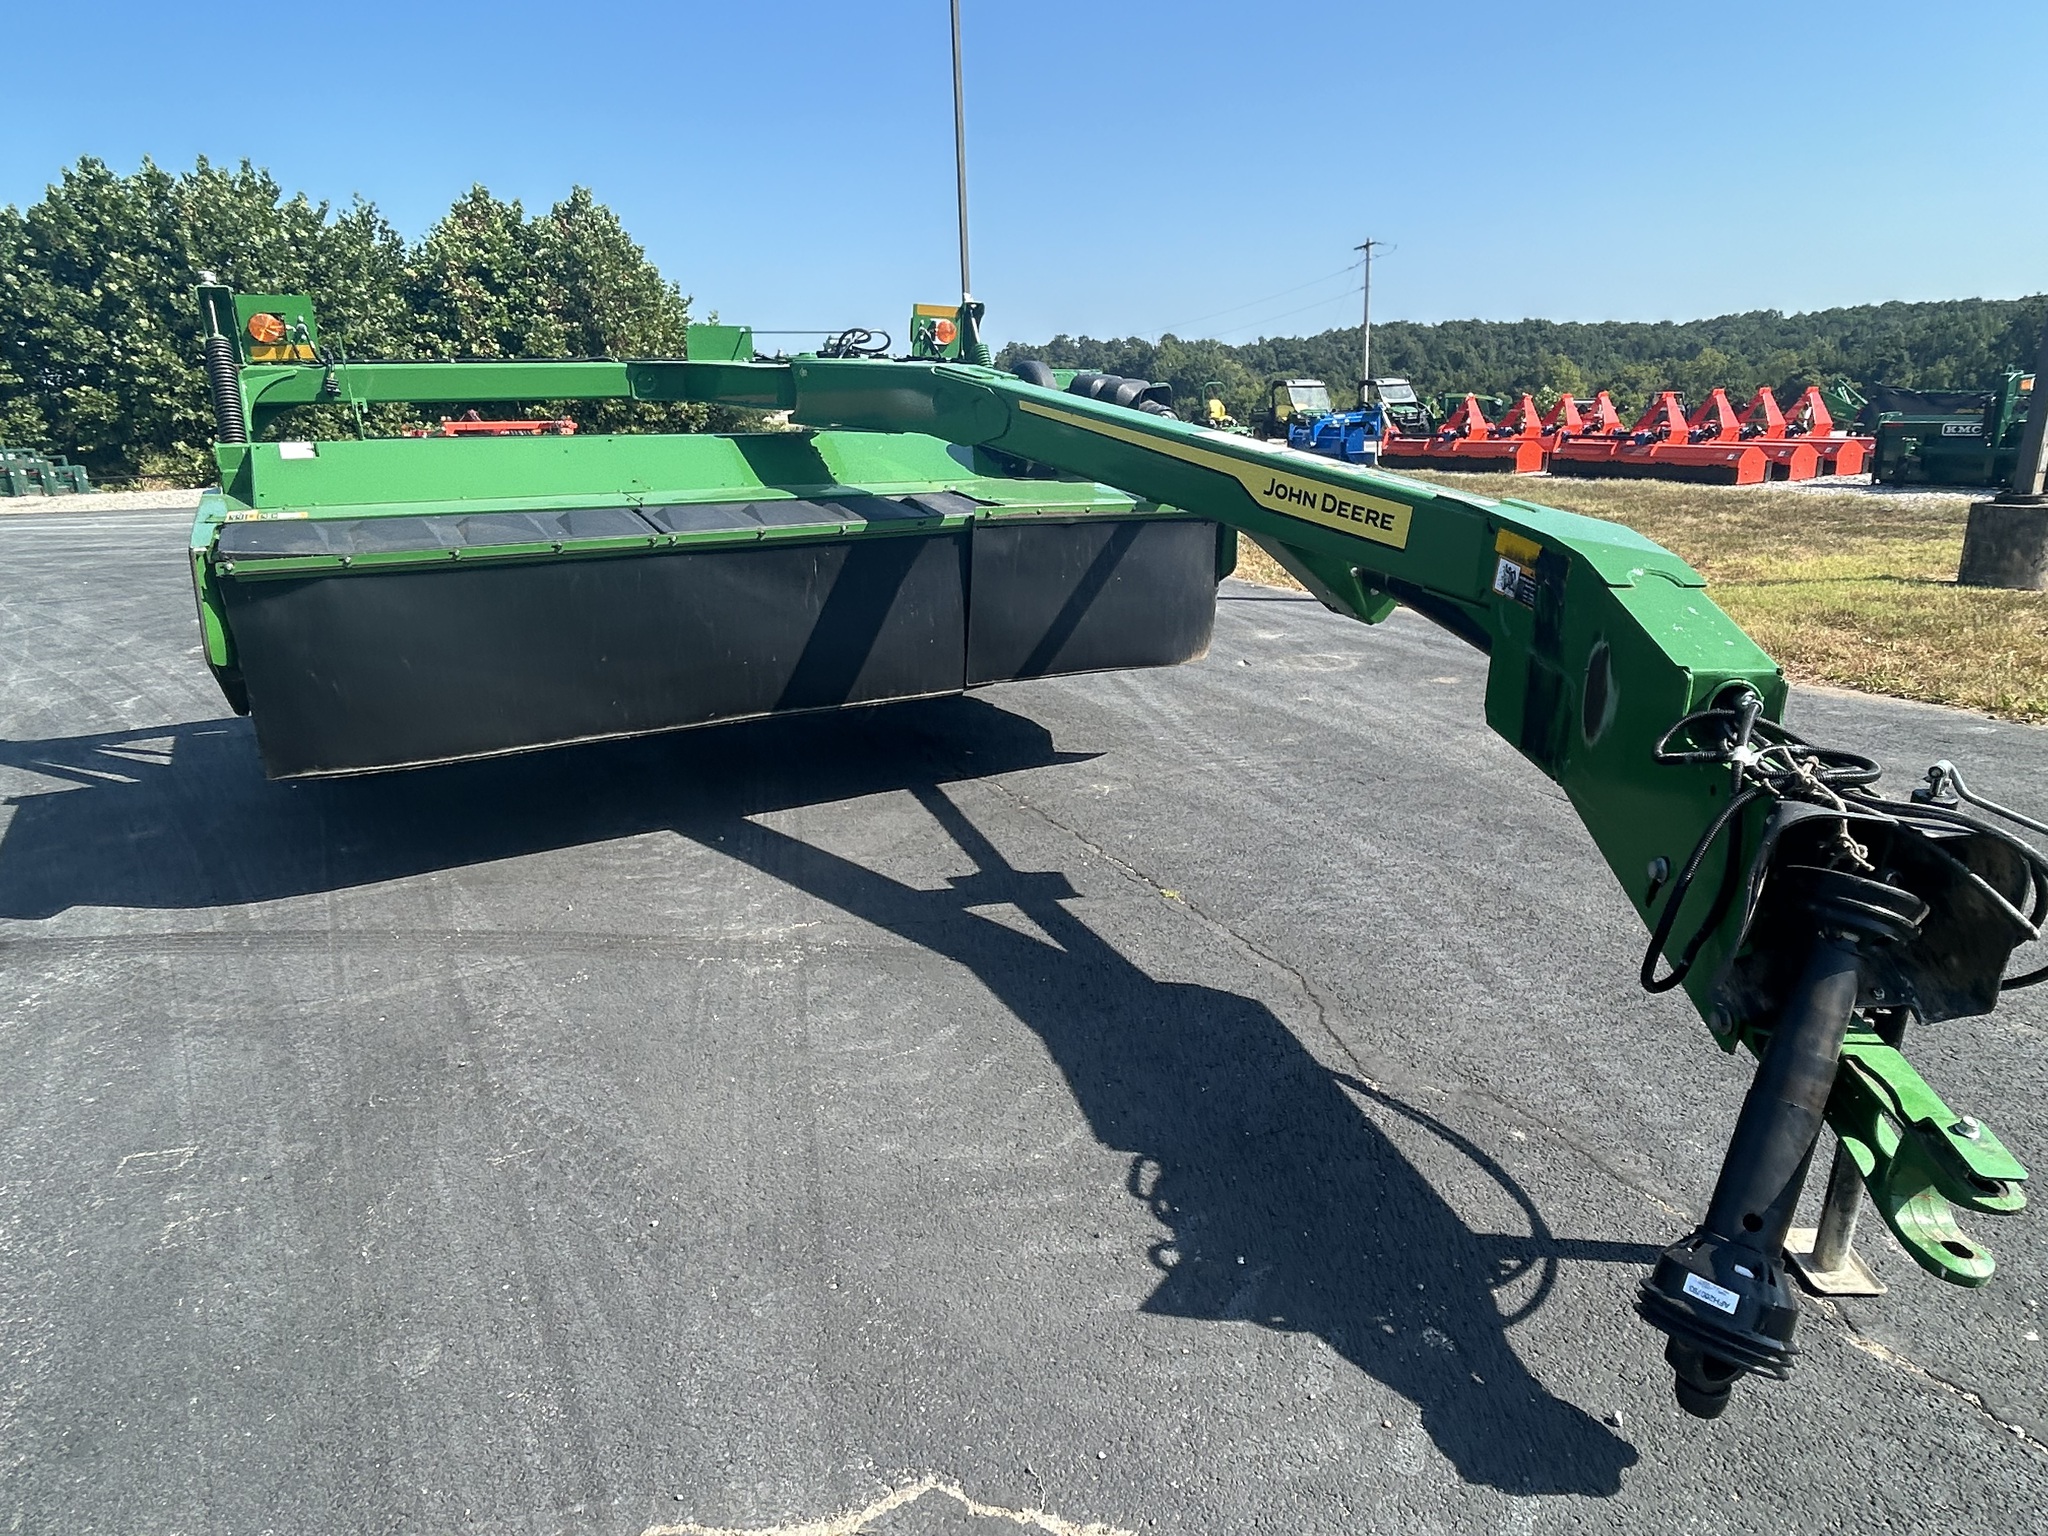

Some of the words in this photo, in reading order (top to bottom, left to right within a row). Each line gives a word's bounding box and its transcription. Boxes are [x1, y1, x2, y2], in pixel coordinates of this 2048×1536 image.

[1946, 426, 1982, 434] KMC
[1263, 478, 1317, 509] JOHN
[1320, 492, 1395, 531] DEERE
